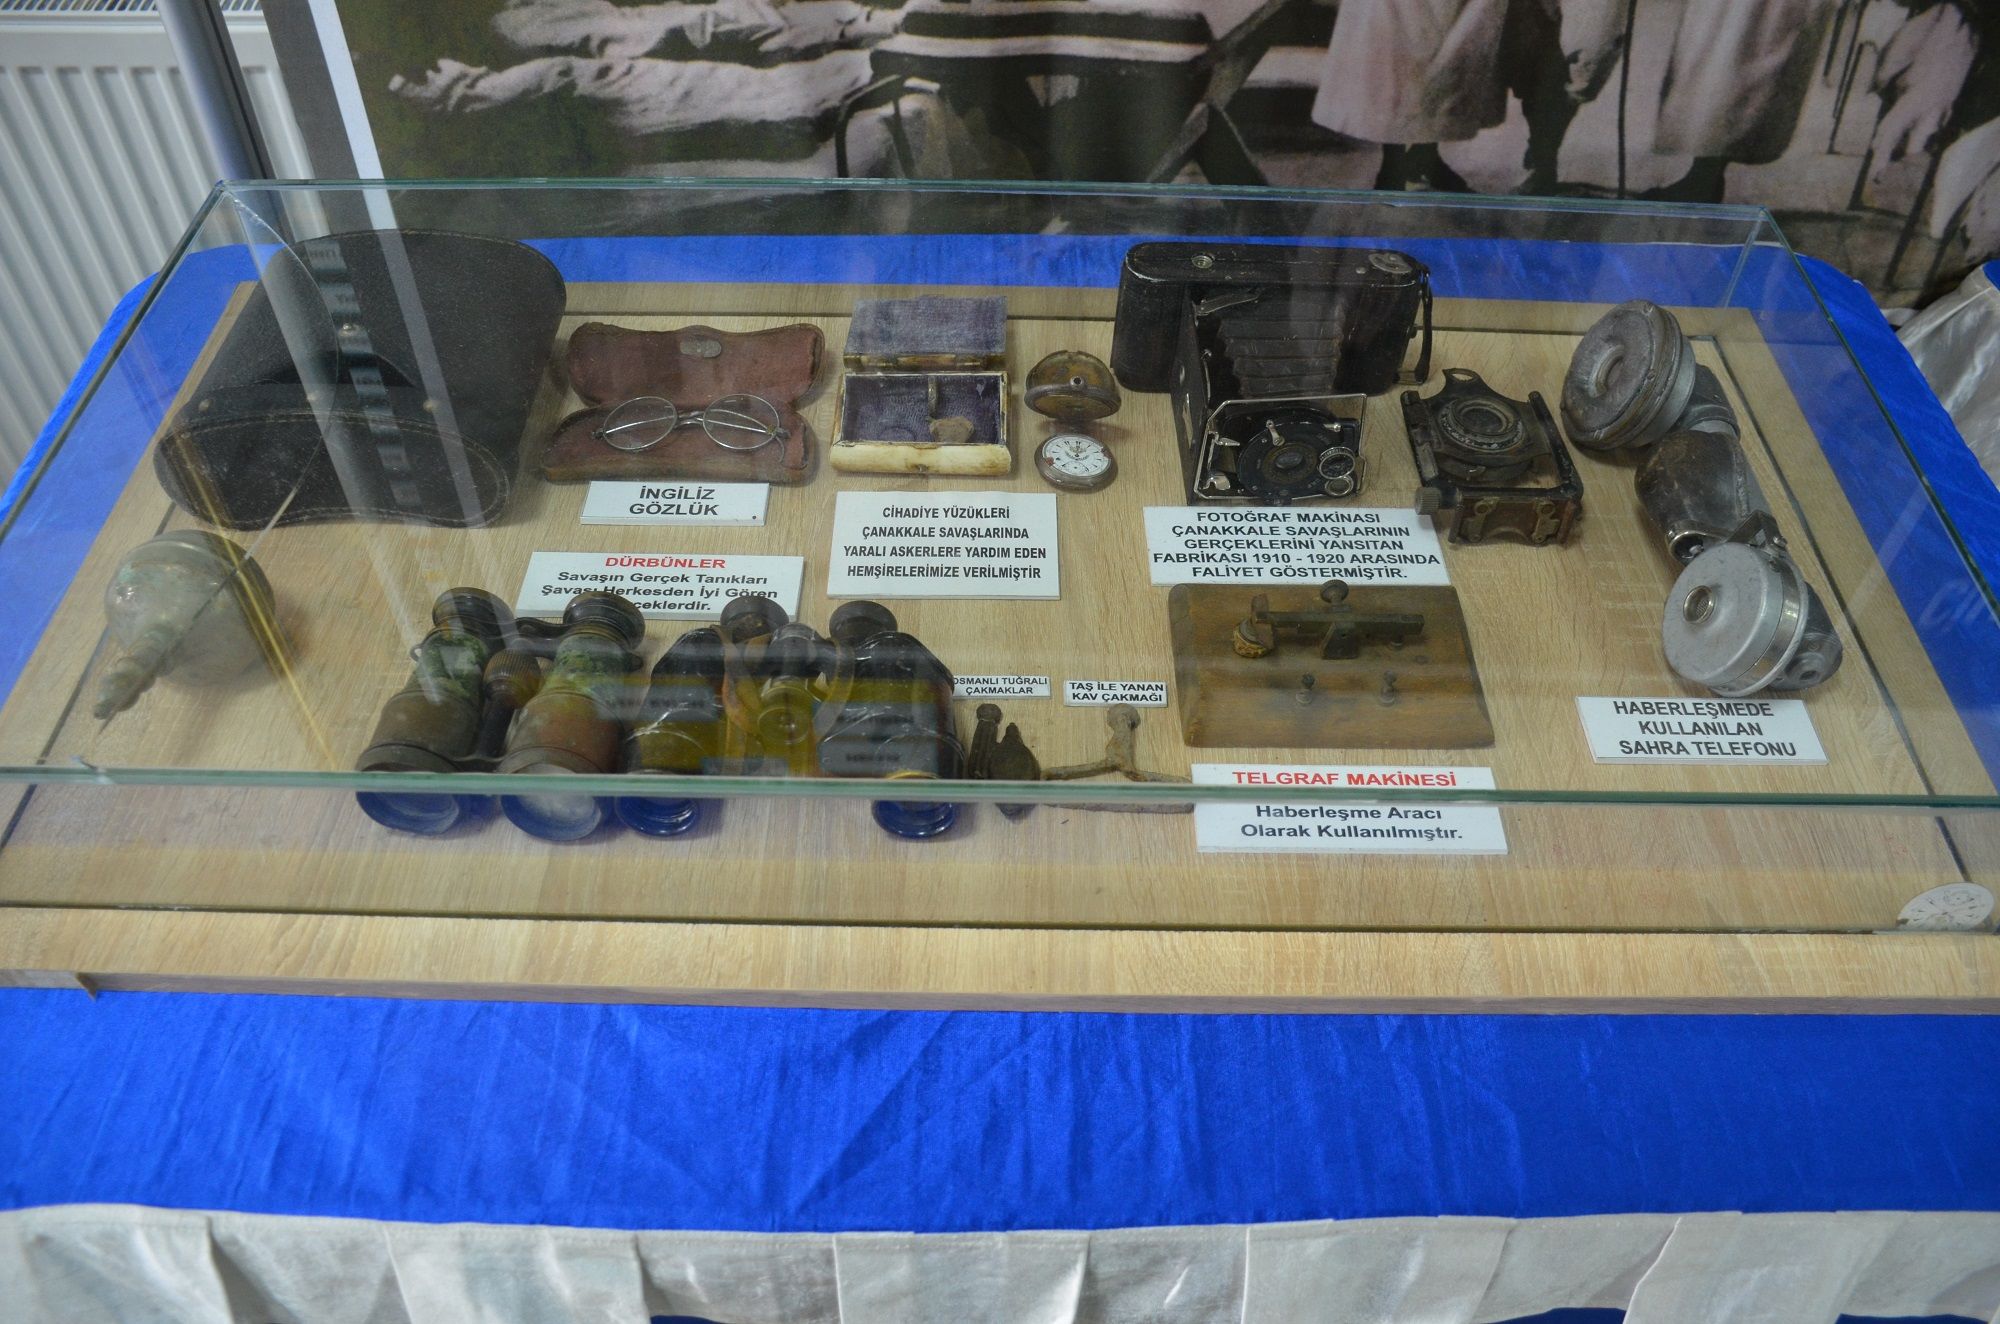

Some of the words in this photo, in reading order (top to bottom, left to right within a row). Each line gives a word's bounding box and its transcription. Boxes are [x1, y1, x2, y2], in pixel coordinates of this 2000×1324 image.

[640, 486, 715, 499] İNGİLİZ
[630, 501, 719, 515] GÖZLÜK
[883, 505, 939, 518] CİHADİYE
[943, 505, 1009, 518] YÜZÜKLERİ
[1197, 511, 1291, 522] FOTOĞRAF
[1297, 511, 1380, 523] MAKİNASI
[863, 527, 935, 539] ÇANAKKALE
[939, 527, 1029, 540] SAVAŞLARINDA
[1172, 526, 1281, 537] ÇANAKKALE
[1286, 526, 1410, 540] SAVAŞLARININ
[844, 546, 886, 556] YARALI
[890, 546, 961, 557] ASKERLERE
[965, 547, 1010, 558] YARDIM
[1015, 548, 1046, 558] EDEN
[1185, 538, 1315, 553] GERÇEKLERİNİ
[1319, 540, 1403, 550] YANSITAN
[606, 556, 725, 568] DÜRBÜNLER
[1154, 551, 1247, 563] FABRİKASI
[1253, 554, 1290, 563] 1910
[1307, 554, 1344, 563] 1920
[1350, 554, 1440, 565] ARASINDA
[558, 572, 624, 583] Savaşın
[630, 573, 689, 584] Gerçek
[696, 574, 767, 584] Tanıkları
[848, 563, 959, 579] HEMŞİRELERİMİZE
[963, 565, 1041, 581] VERİLMİŞTİR
[1193, 565, 1264, 577] FALİYET
[1270, 565, 1407, 581] GÖSTERMİŞTİR.
[604, 586, 694, 597] Herkesden
[700, 586, 719, 599] İyi
[725, 588, 777, 598] Gören
[1002, 675, 1047, 685] TUĞRALI
[1069, 682, 1094, 692] TAŞ
[1097, 681, 1117, 691] İLE
[1120, 683, 1164, 692] YANAN
[965, 686, 1033, 695] ÇAKMAKLAR
[1072, 692, 1098, 701] KAV
[1101, 692, 1163, 703] ÇAKMAĞI
[1613, 701, 1774, 719] HABERLEŞMEDE
[1639, 721, 1763, 735] KULLANILAN
[1619, 740, 1690, 755] SAHRA
[1695, 742, 1796, 756] TELEFONU
[1232, 772, 1338, 786] TELGRAF
[1347, 771, 1456, 786] MAKİNESİ
[1256, 805, 1382, 821] Haberleşme
[1388, 807, 1441, 819] Aracı
[1241, 824, 1310, 837] Olarak
[1317, 825, 1462, 841] Kullanılmıştır.
